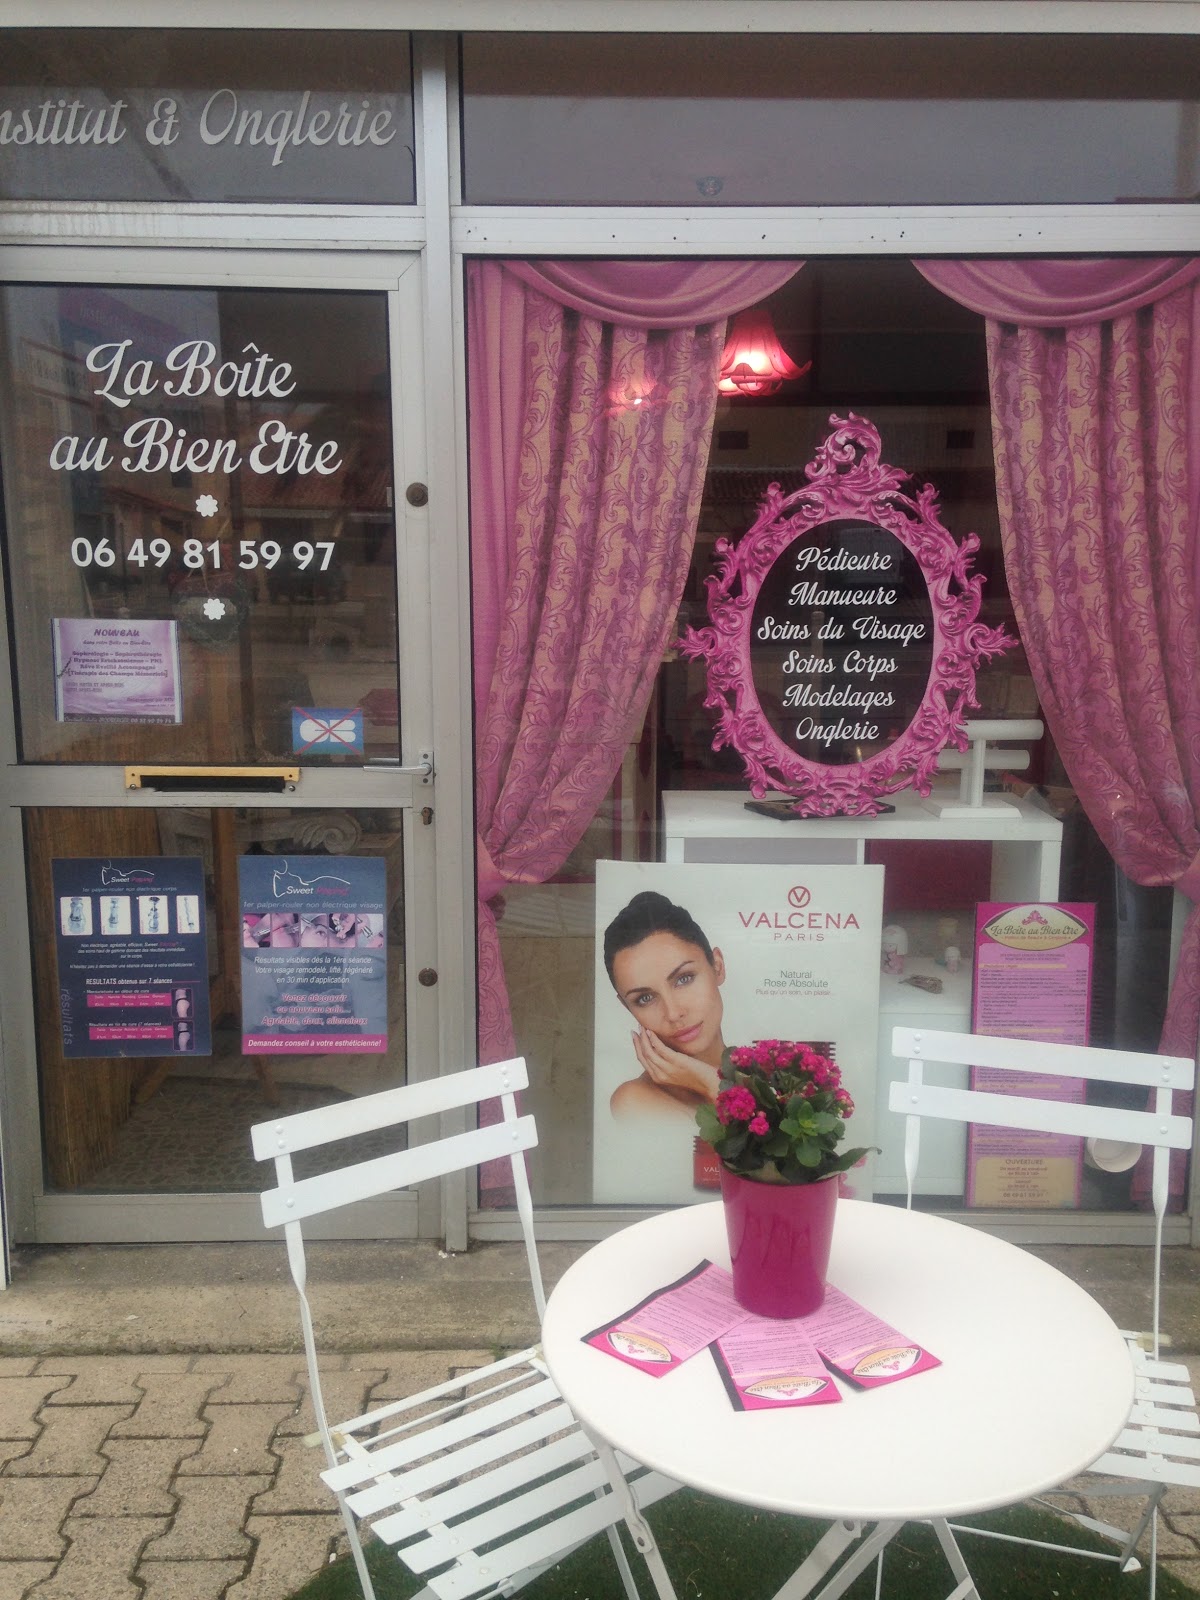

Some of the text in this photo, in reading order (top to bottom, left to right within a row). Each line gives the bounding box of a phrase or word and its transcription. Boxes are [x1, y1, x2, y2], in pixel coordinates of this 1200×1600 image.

[145, 98, 180, 147] &
[200, 88, 397, 166] Onglerie
[86, 339, 160, 408] La
[164, 340, 297, 398] Boîte
[49, 417, 343, 475] au Bien Etre
[71, 537, 336, 571] 06 49 81 59 97
[795, 547, 893, 572] Pédicure
[788, 581, 898, 606] Manucure
[757, 615, 926, 647] Soins du Visage
[782, 650, 899, 681] Soins Corps
[782, 683, 896, 715] Modelages
[795, 717, 880, 748] Onglerie
[286, 886, 314, 895] Sweet
[738, 911, 860, 930] VALCENA
[990, 925, 1002, 936] La
[1040, 926, 1061, 935] Bien
[774, 933, 825, 942] PARIS
[274, 966, 294, 974] visage
[764, 978, 828, 988] Rose Absolute
[780, 970, 812, 979] Natural
[60, 988, 73, 1045] résultats
